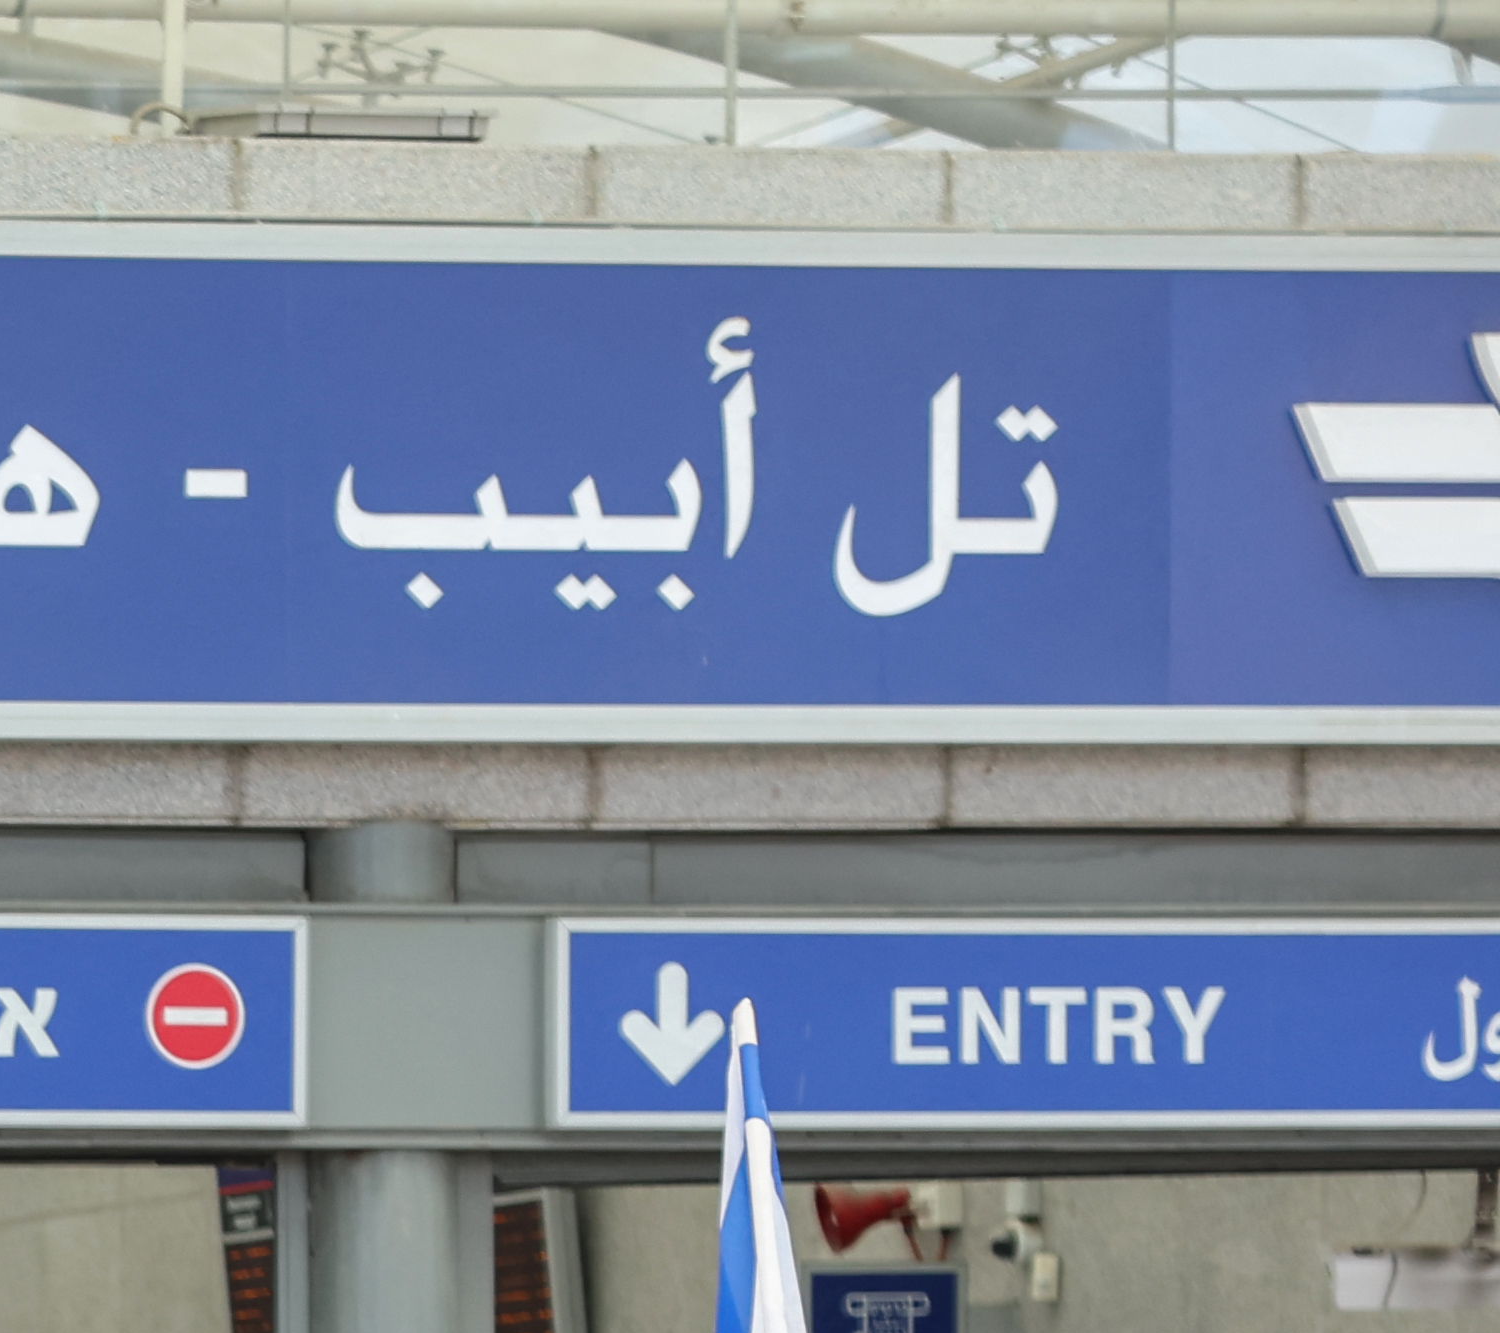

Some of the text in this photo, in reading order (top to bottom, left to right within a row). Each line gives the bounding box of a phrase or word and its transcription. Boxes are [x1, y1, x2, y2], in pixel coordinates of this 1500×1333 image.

[335, 317, 757, 611] أبيب
[834, 374, 1058, 617] تل
[893, 986, 1225, 1065] ENTRY
